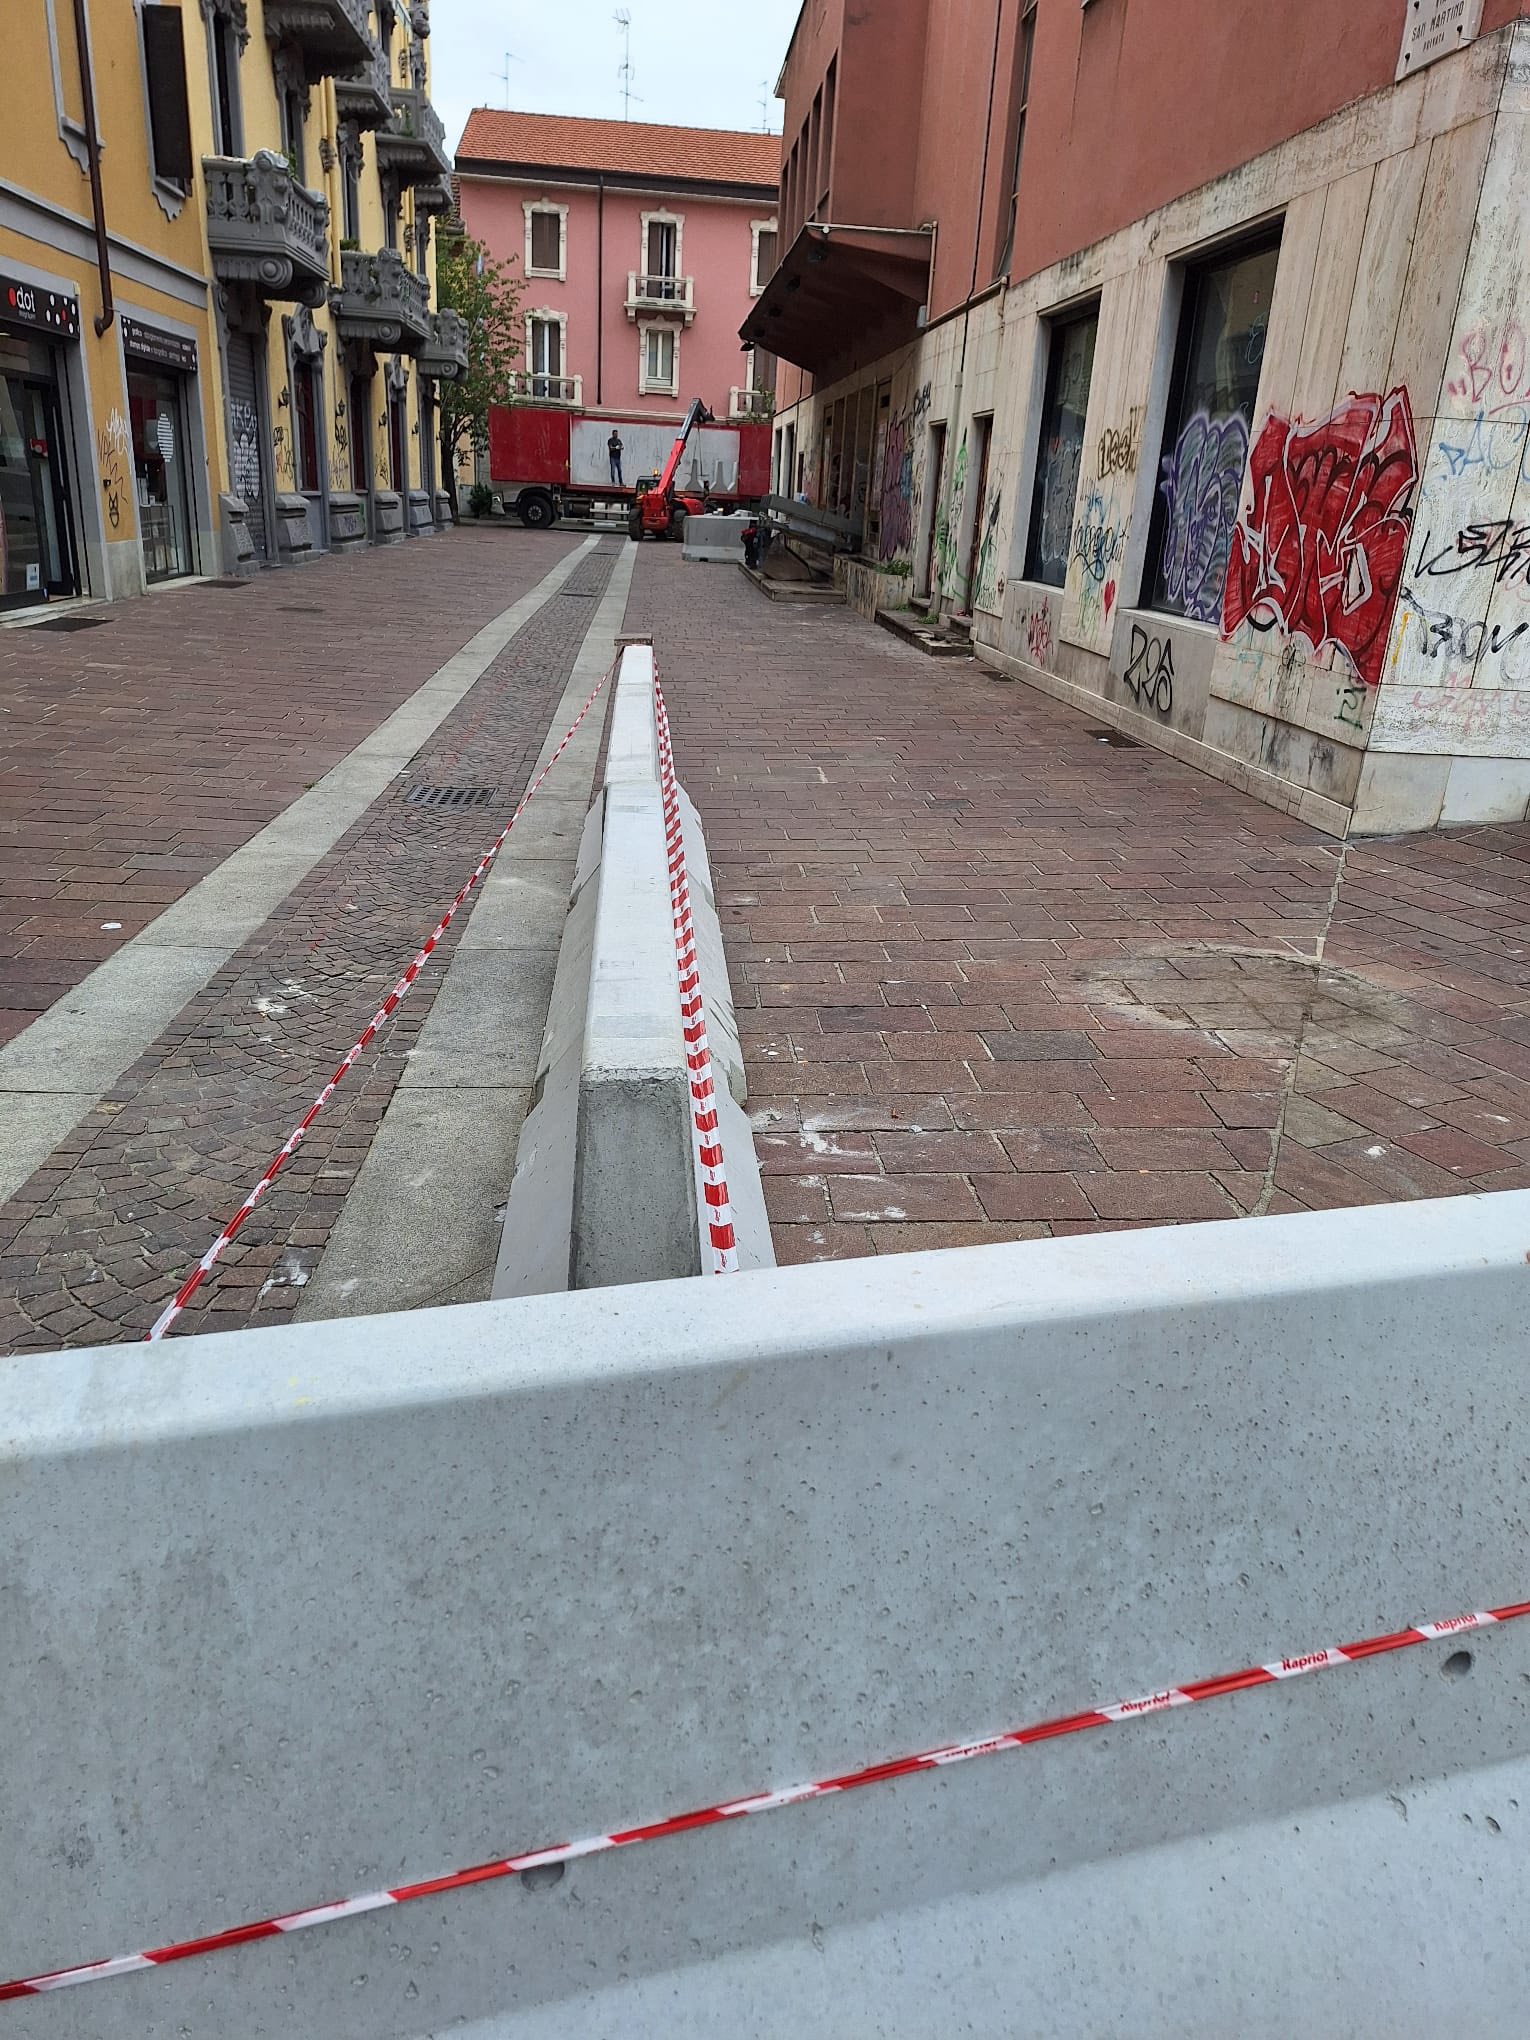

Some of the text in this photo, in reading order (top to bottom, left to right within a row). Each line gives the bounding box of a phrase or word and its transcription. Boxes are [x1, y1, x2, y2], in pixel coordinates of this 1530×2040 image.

[1411, 1, 1465, 41] SAN MARTINO
[17, 286, 36, 313] dot
